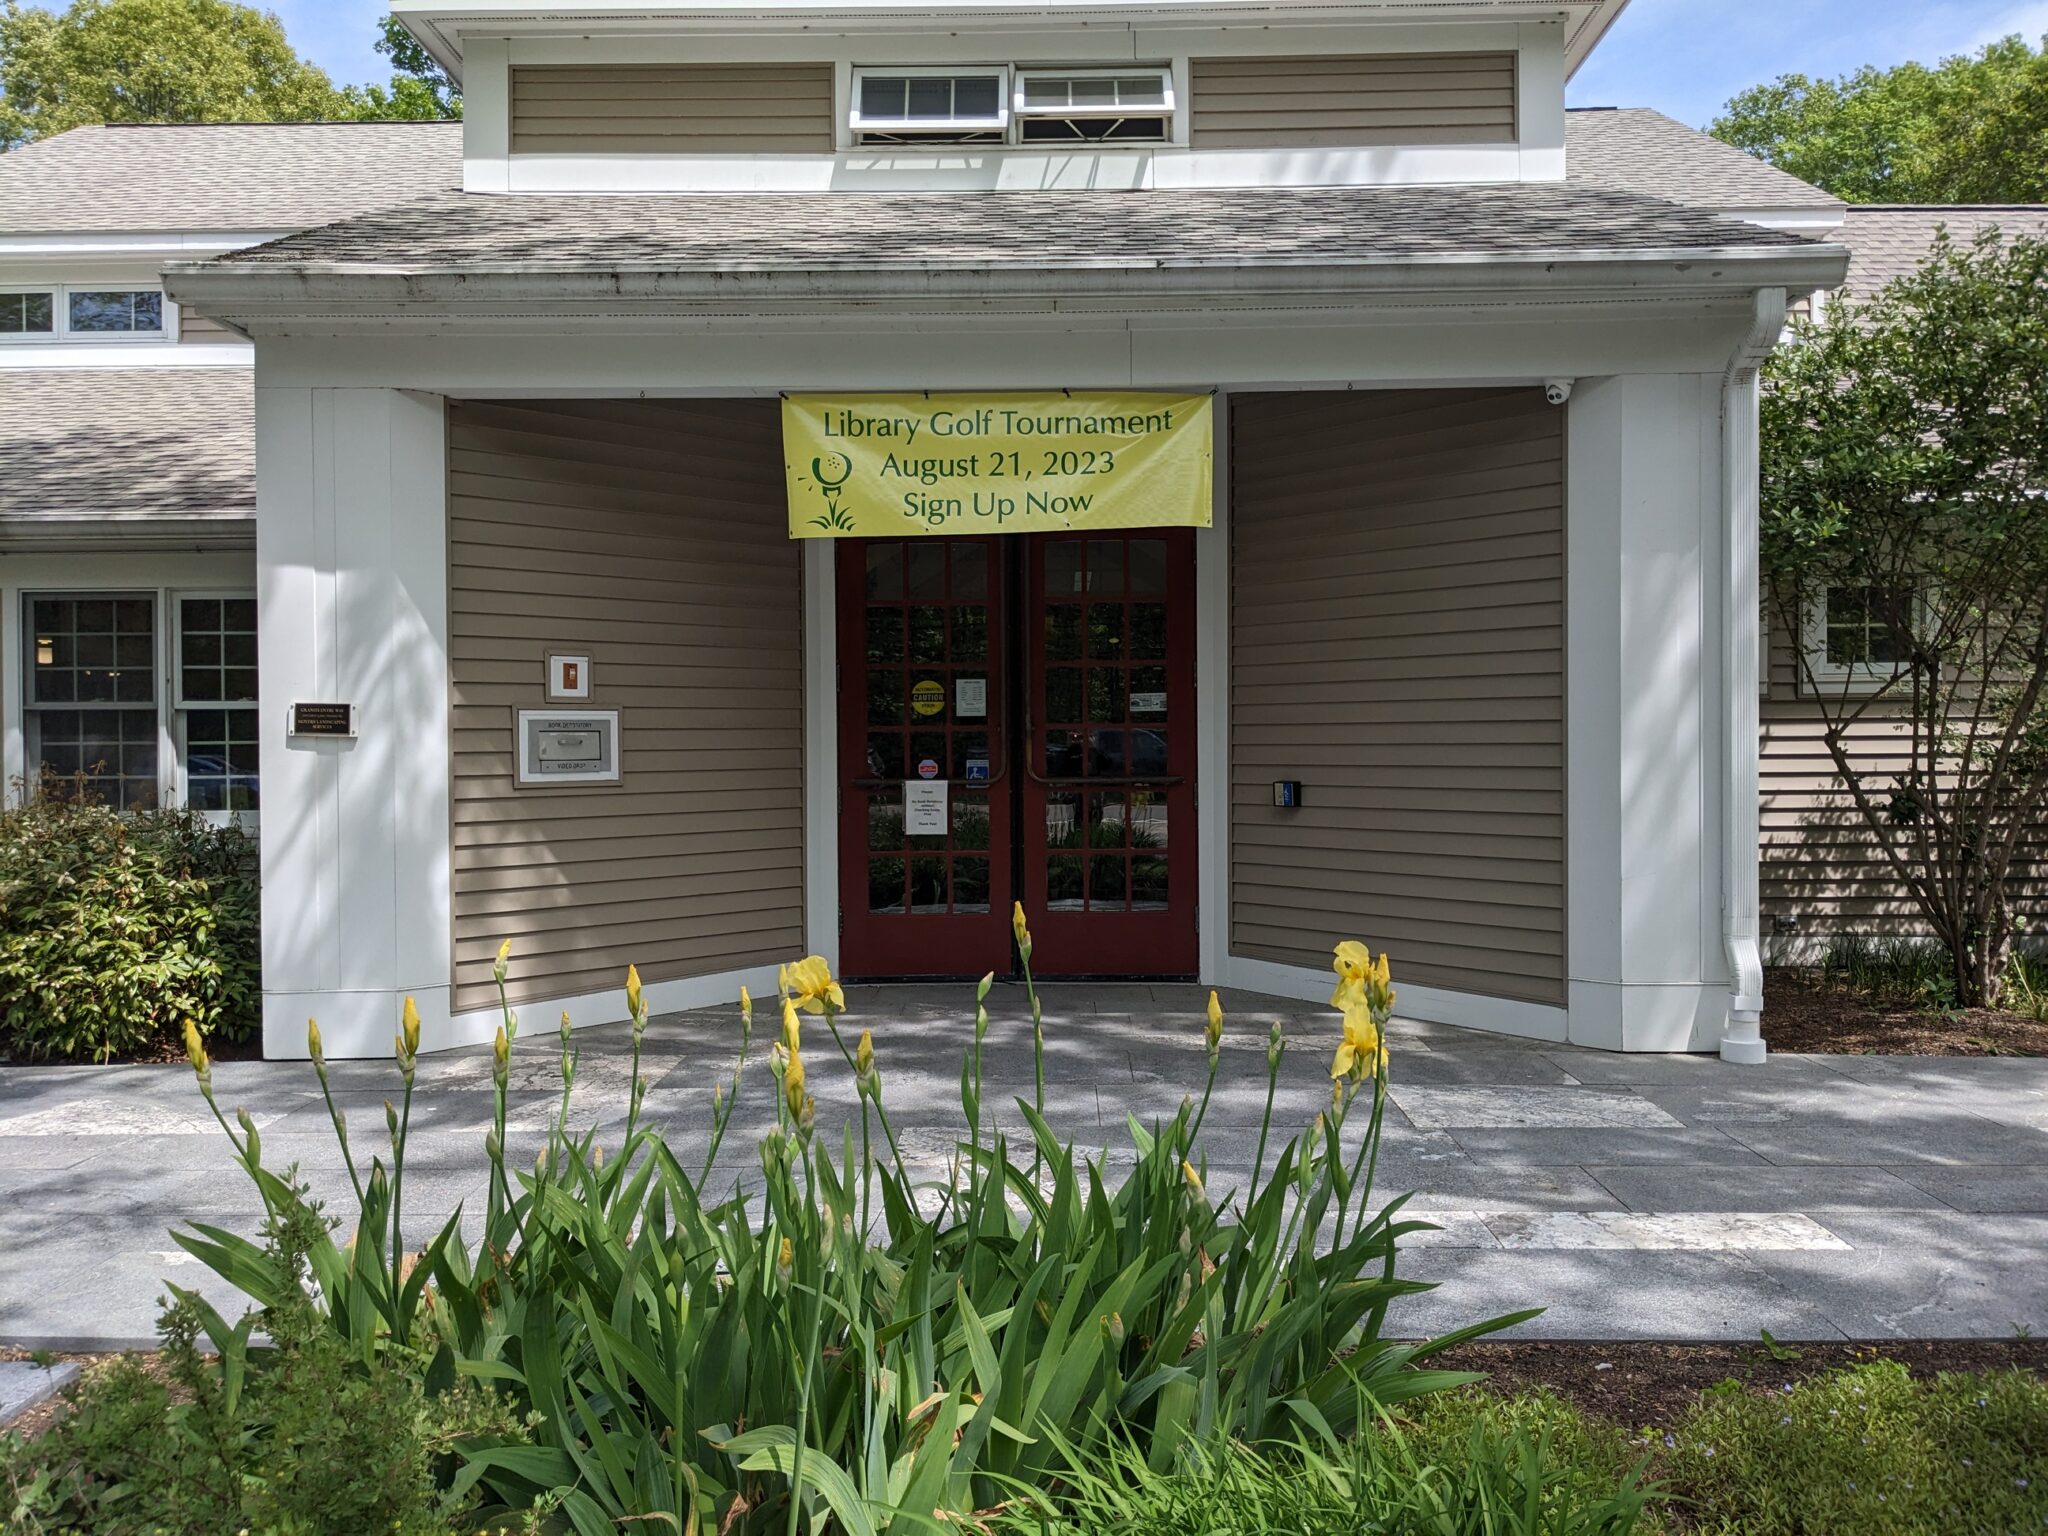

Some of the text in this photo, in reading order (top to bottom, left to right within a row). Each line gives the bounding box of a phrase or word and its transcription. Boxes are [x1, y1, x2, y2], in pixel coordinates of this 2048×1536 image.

[823, 409, 1173, 445] Library Golf Tournament
[880, 450, 1115, 485] August 21, 2023
[903, 491, 1094, 526] Sign Up Now
